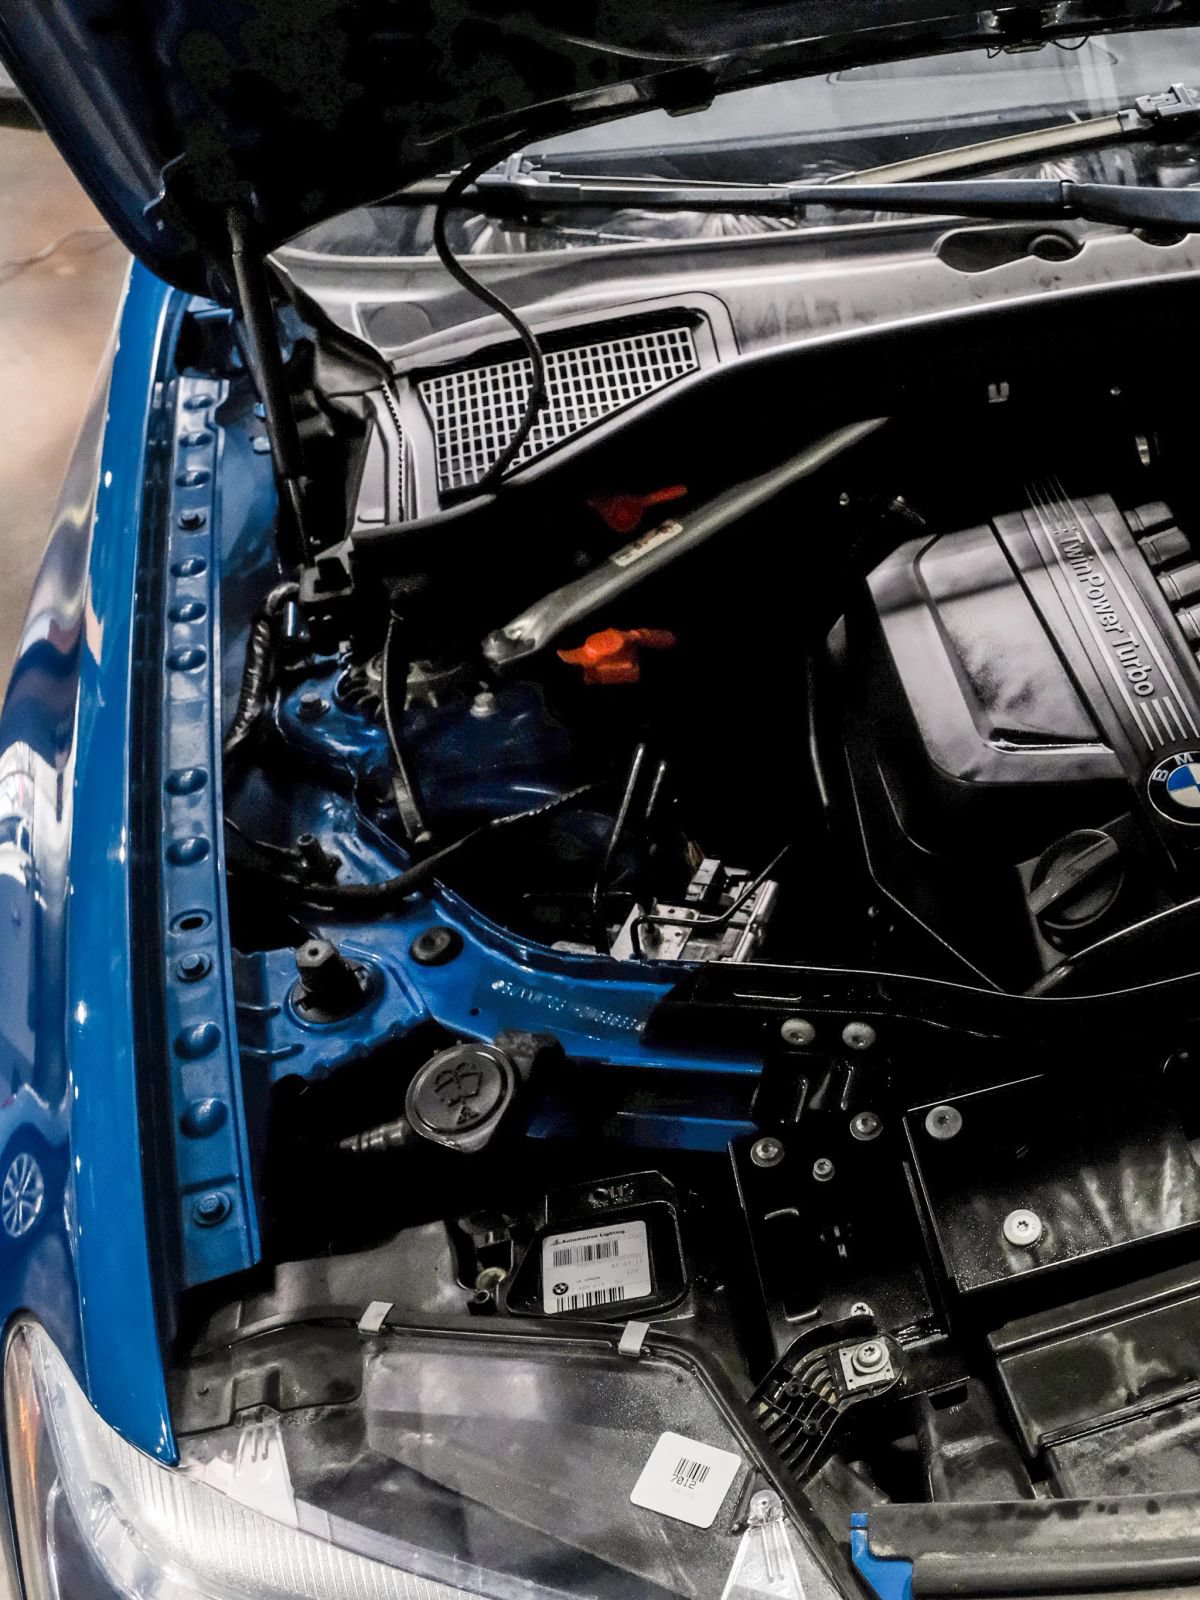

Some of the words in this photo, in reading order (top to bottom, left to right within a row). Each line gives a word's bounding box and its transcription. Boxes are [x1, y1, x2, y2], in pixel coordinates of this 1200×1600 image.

[1060, 531, 1123, 635] TwinPower
[1112, 634, 1154, 697] Turbo
[599, 1230, 625, 1238] Lighting
[670, 1473, 697, 1490] 7012
